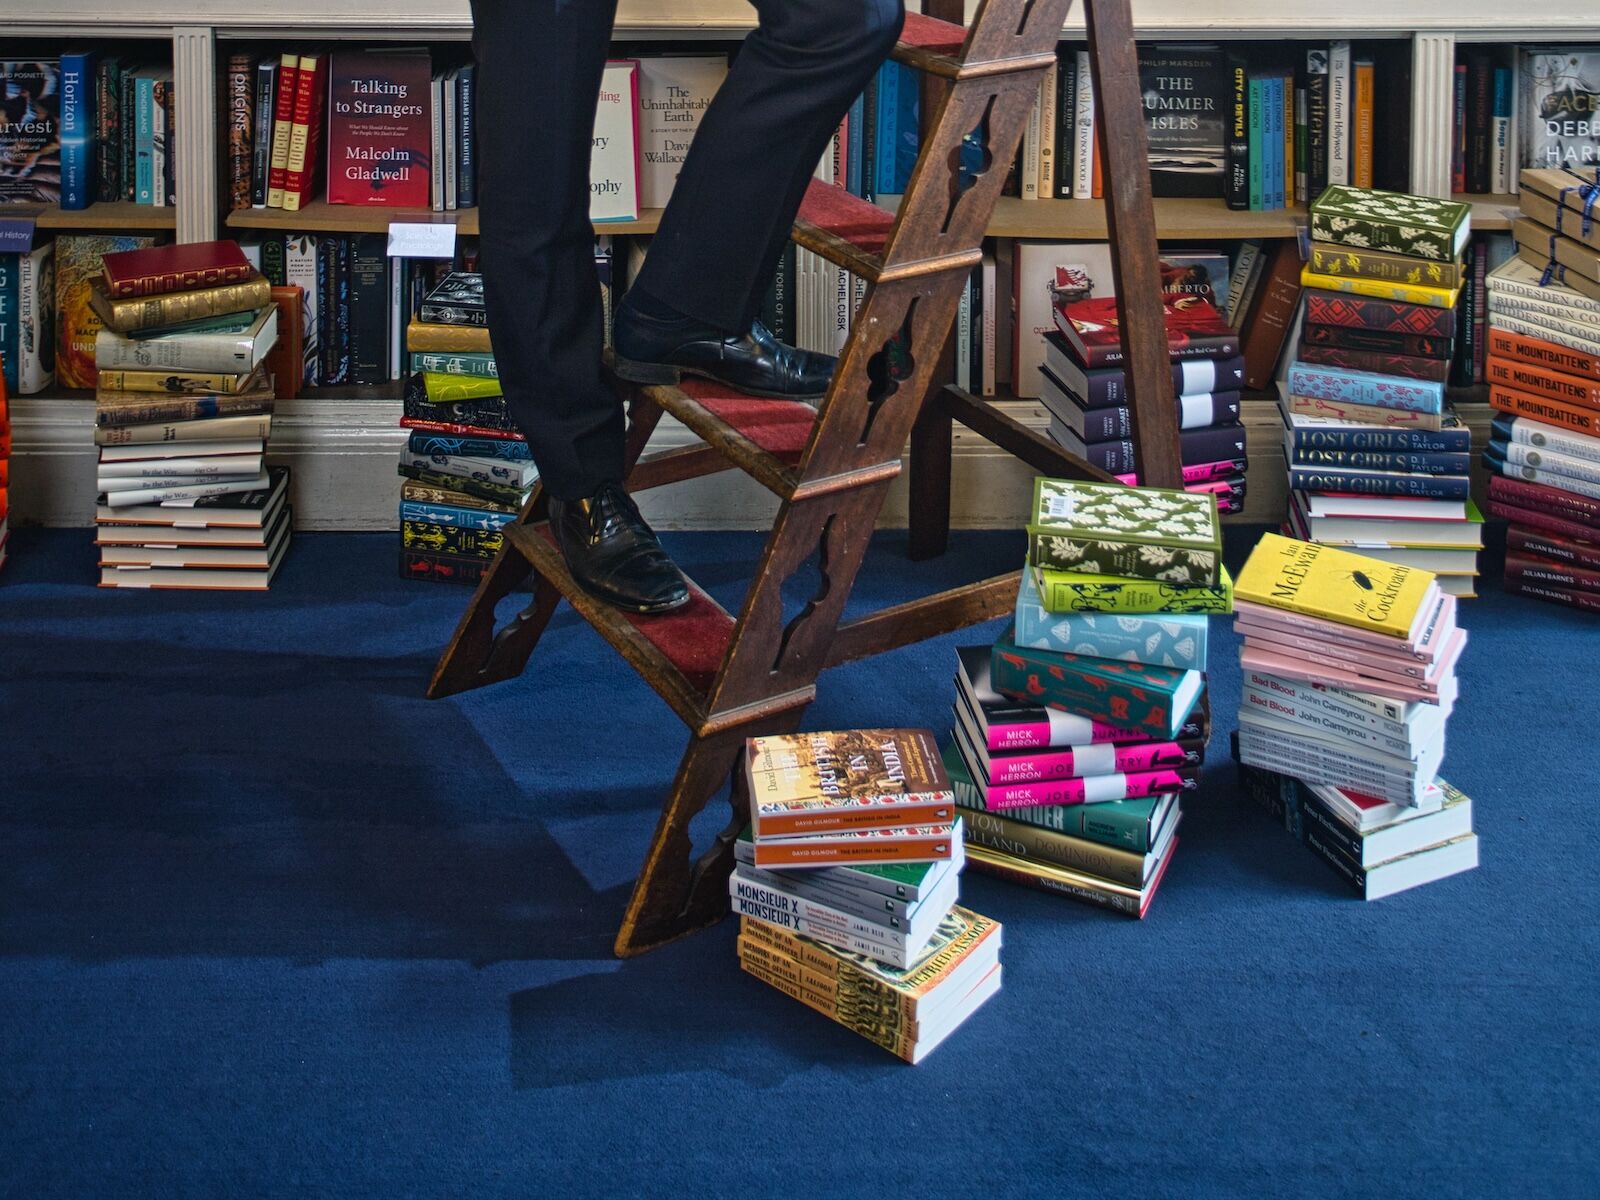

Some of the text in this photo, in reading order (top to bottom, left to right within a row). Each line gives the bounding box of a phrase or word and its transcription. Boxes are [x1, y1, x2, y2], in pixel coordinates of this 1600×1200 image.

[351, 80, 408, 98] Talking
[666, 87, 689, 98] The
[1156, 77, 1194, 91] THE
[64, 72, 78, 131] Horizon
[235, 73, 246, 131] ORIGINS
[336, 100, 423, 118] to Strangers
[1235, 68, 1243, 137] CITY DEVILS
[1546, 96, 1596, 112] FACE
[664, 111, 694, 122] Earth
[1151, 117, 1199, 130] ISLES
[346, 147, 410, 161] Malcolm
[345, 167, 410, 181] Gladwell
[5, 231, 30, 240] History
[1494, 338, 1590, 371] THE MOUNTBATTENS
[1492, 365, 1587, 399] THE MOUNTBATTENS
[1495, 393, 1590, 427] THE MOUNTBATTENS
[1302, 431, 1408, 448] LOST GIRLS
[1280, 544, 1299, 557] Ian
[1272, 543, 1323, 601] McEwan
[1368, 566, 1410, 621] Cockroach
[1356, 599, 1368, 613] the
[1251, 675, 1366, 723] Bad Blood John Carreyrou
[1250, 694, 1367, 740] Bad Blood John Carreyrou
[1007, 730, 1032, 739] MICK
[880, 741, 906, 782] INDIA
[1008, 763, 1034, 772] MICK
[1000, 771, 1042, 781] HERRON
[969, 813, 1004, 834] TOM
[1035, 837, 1114, 873] DOMINION
[737, 883, 798, 913] MONSIEUR X
[740, 899, 800, 930] MONSIEUR X
[949, 918, 992, 955] SASSOON
